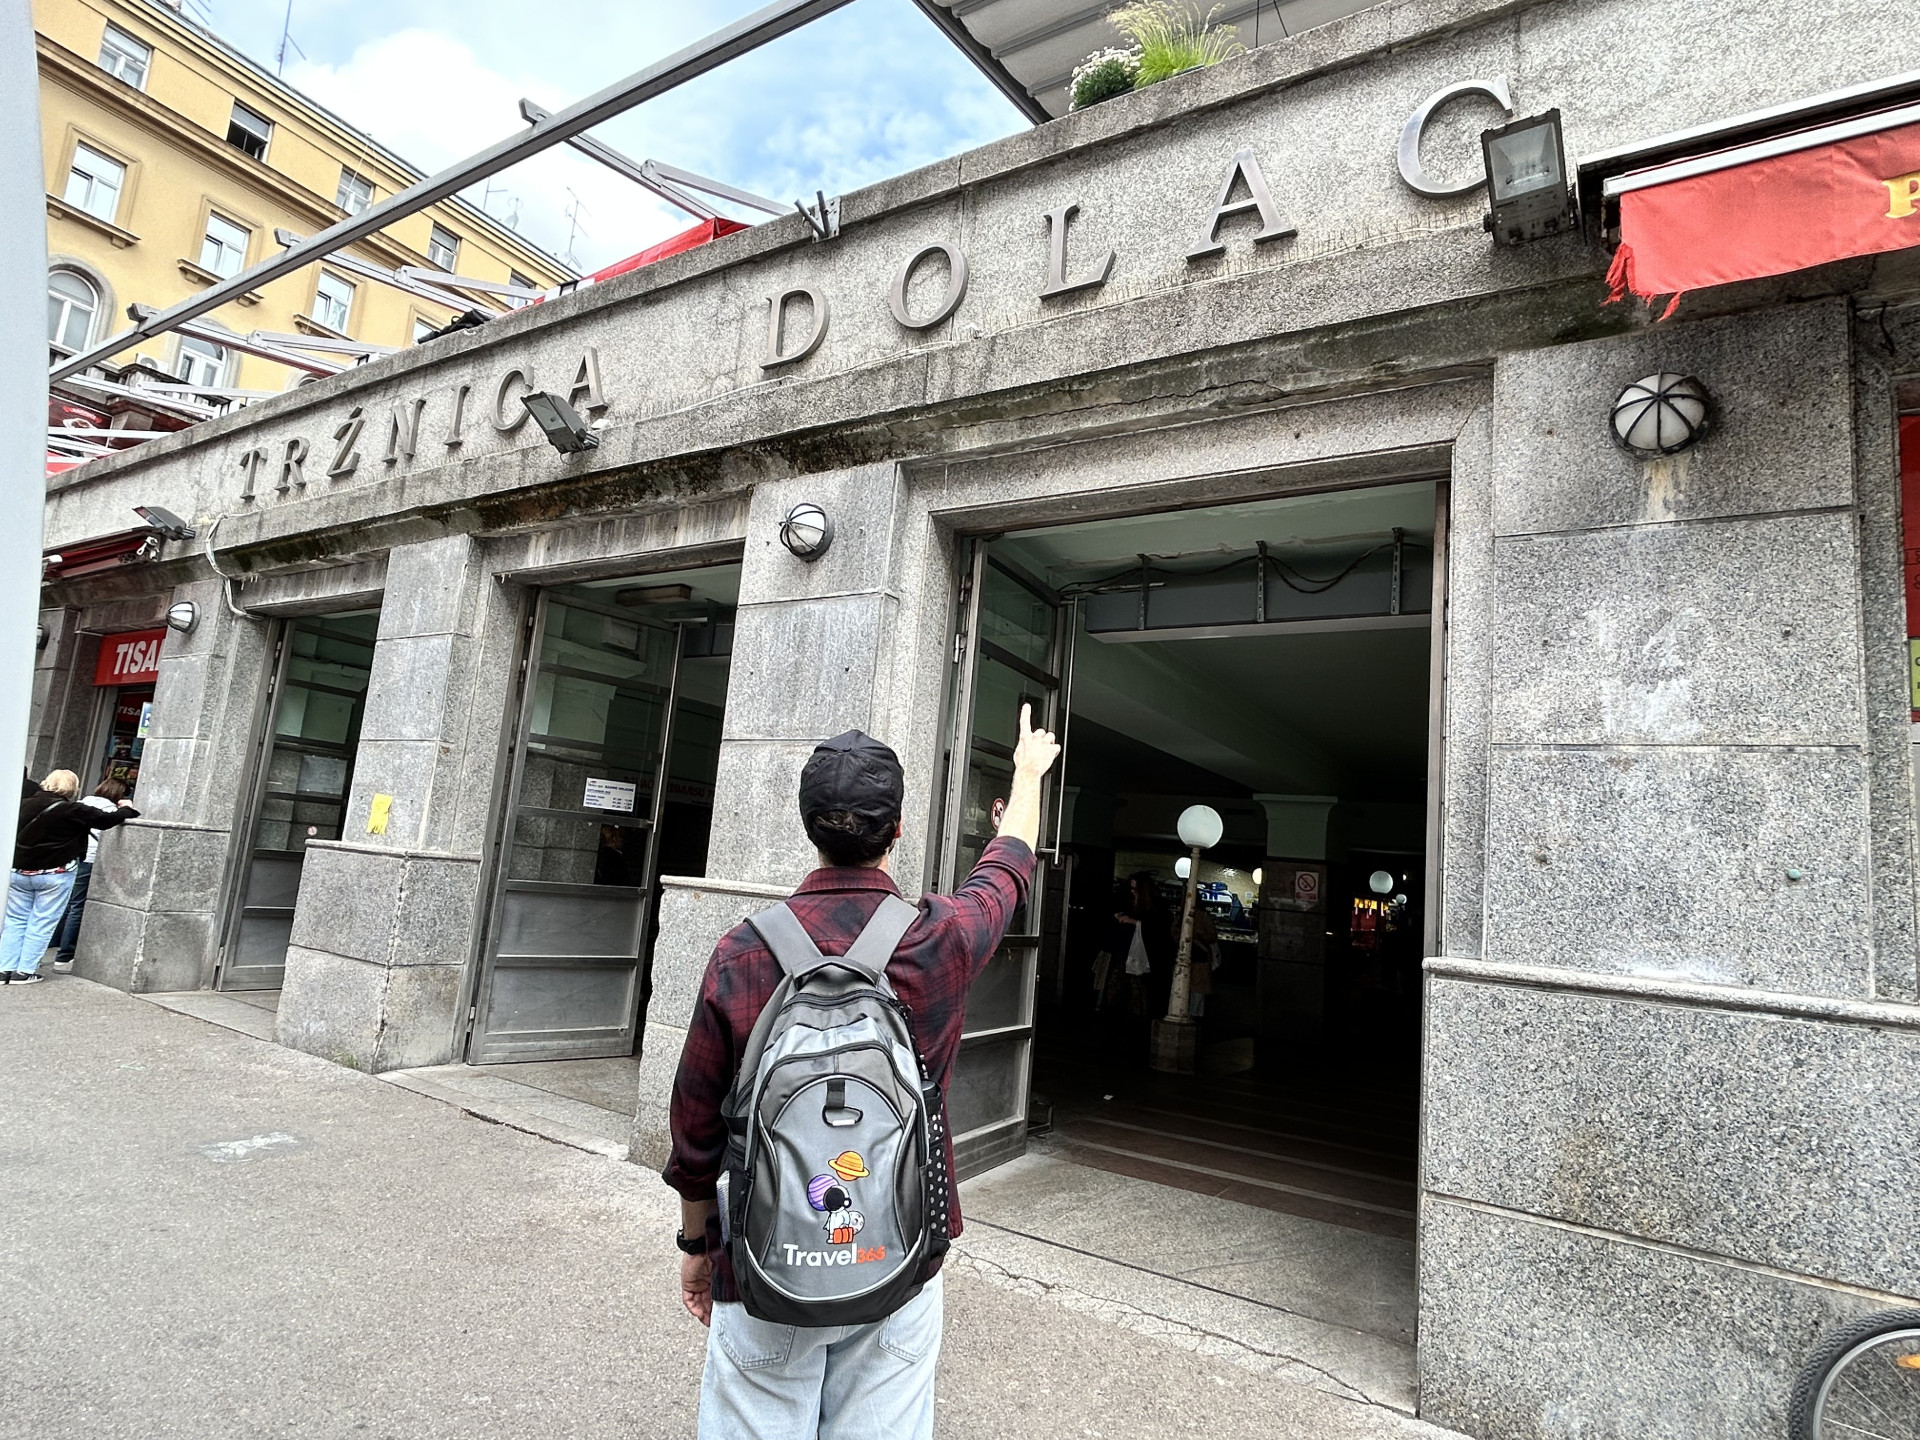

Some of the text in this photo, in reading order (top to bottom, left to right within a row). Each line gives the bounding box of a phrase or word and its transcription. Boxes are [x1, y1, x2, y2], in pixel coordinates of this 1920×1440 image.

[759, 76, 1515, 371] DOLAC
[114, 639, 164, 674] TISA
[783, 1243, 886, 1267] Travel365
